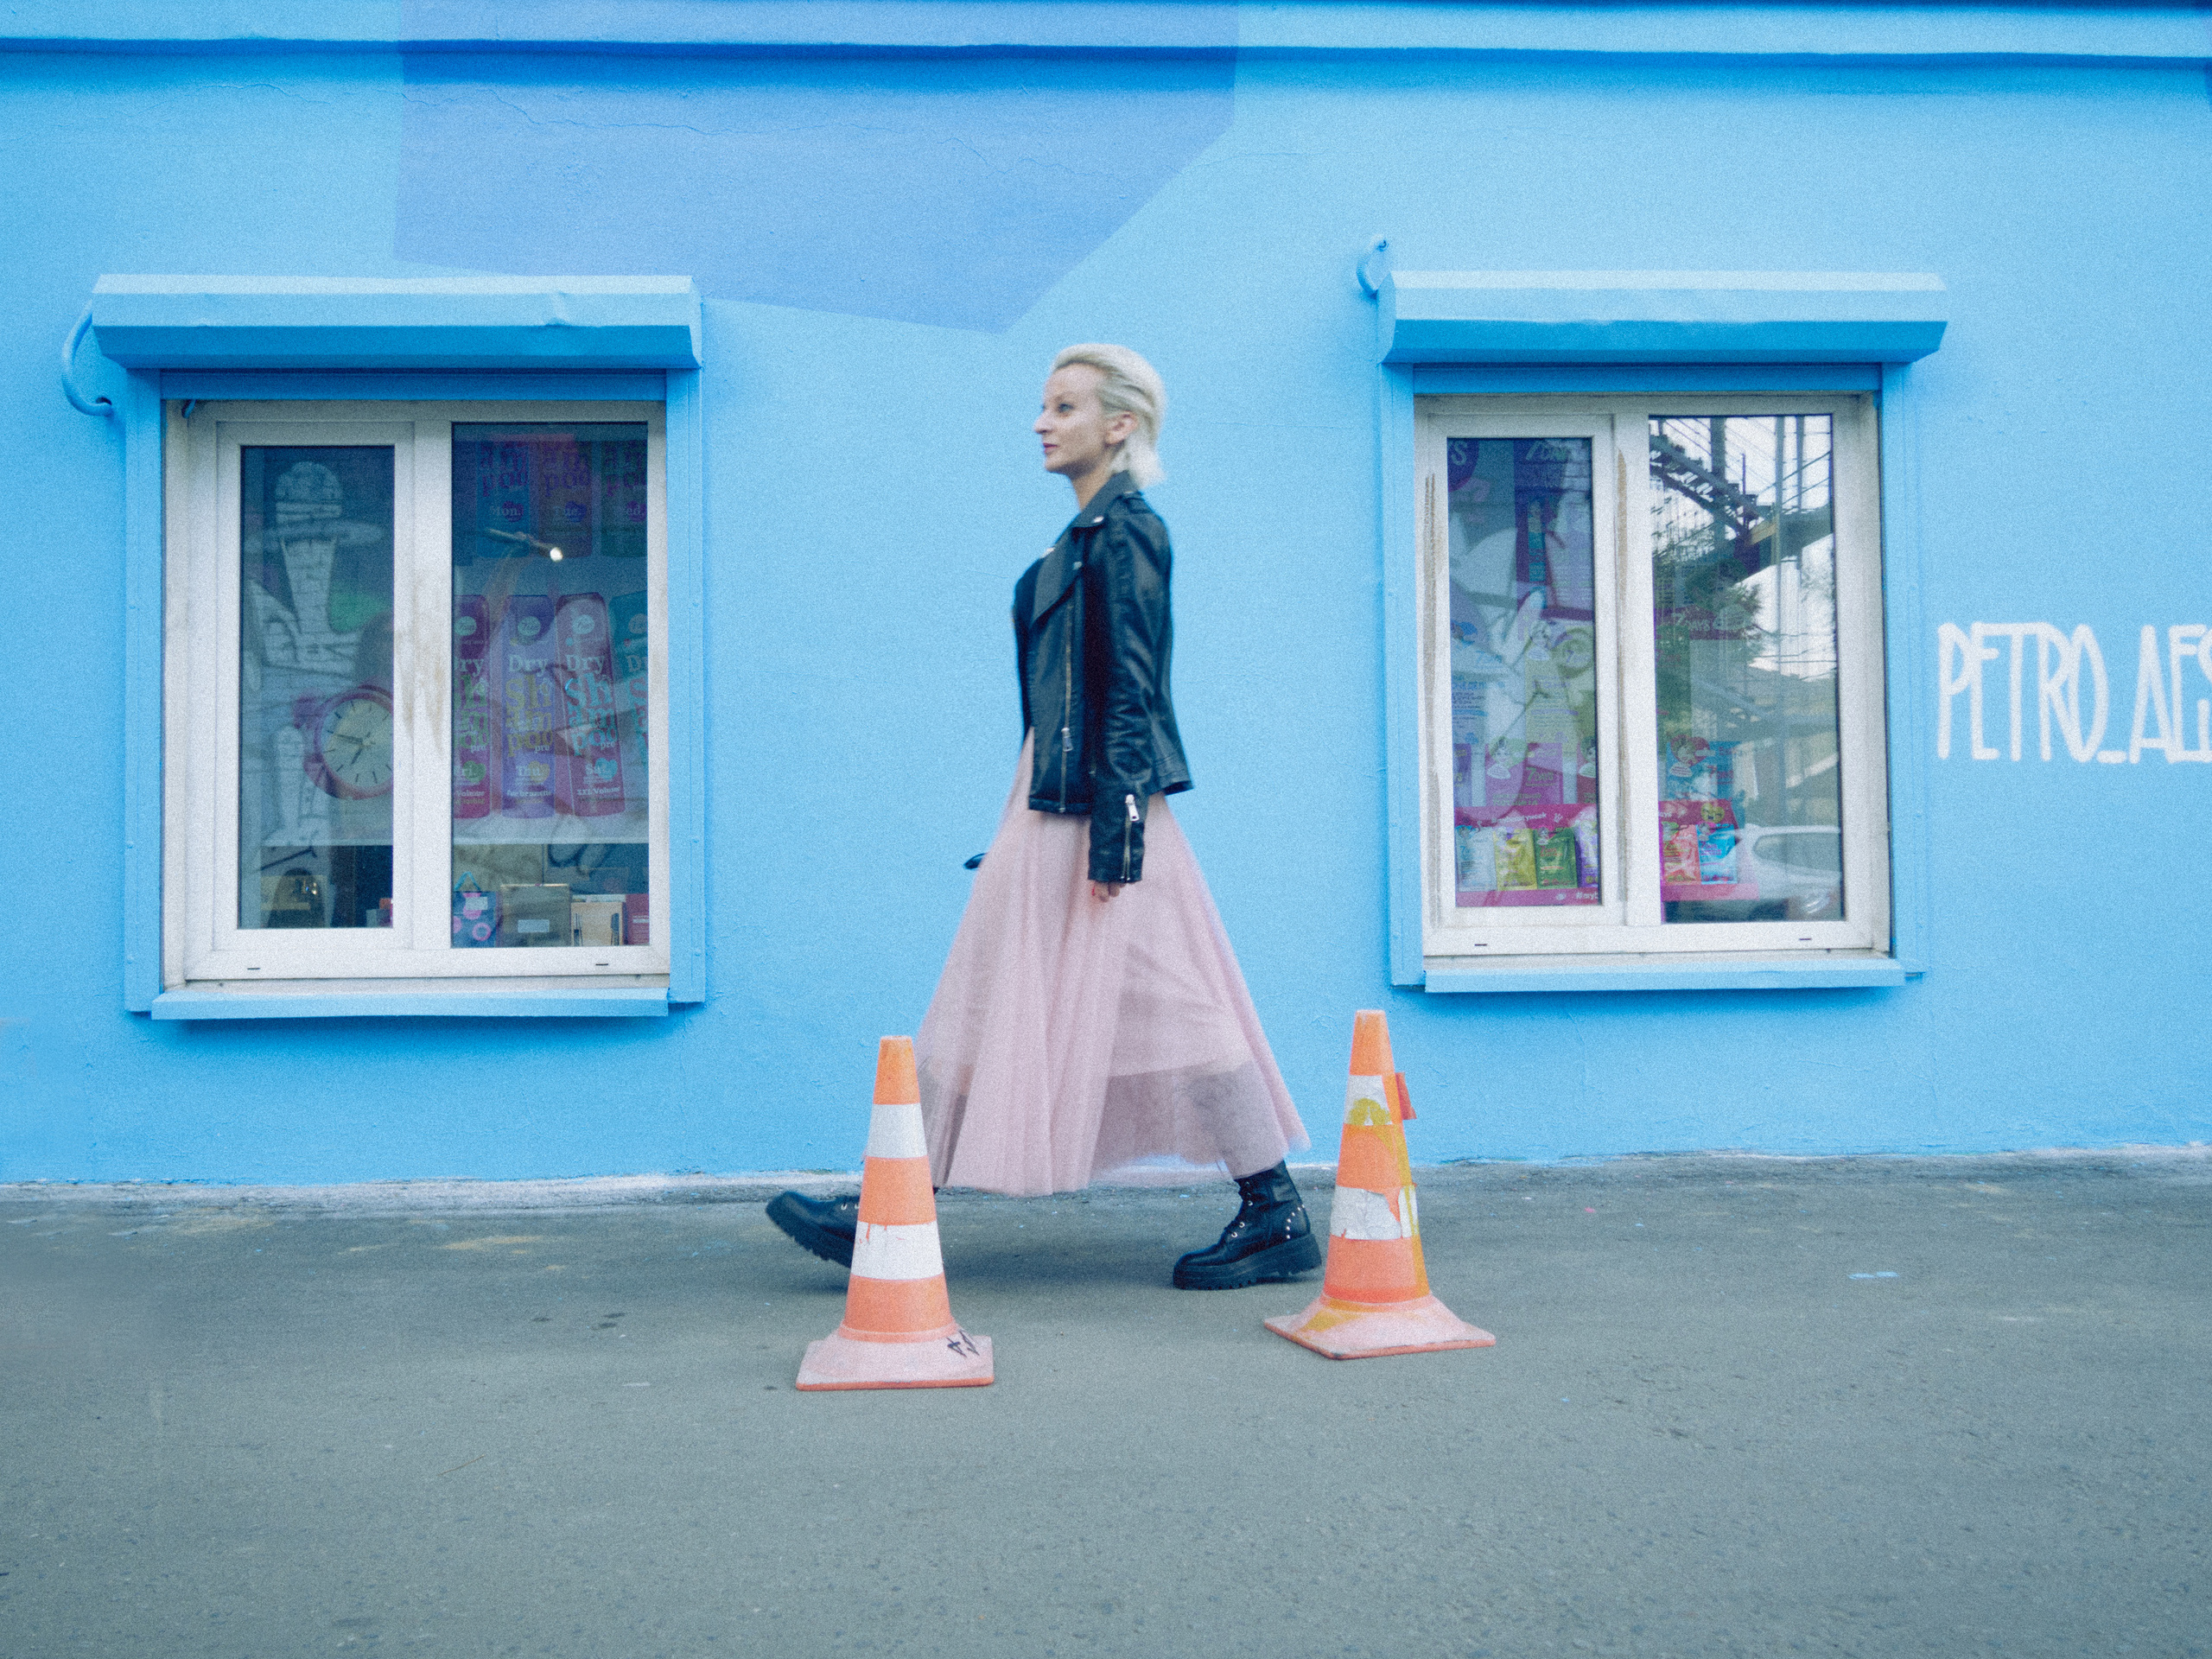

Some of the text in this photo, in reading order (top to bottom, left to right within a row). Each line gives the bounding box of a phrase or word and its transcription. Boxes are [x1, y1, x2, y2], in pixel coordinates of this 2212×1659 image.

[544, 470, 591, 498] poo
[508, 653, 550, 677] Dry
[565, 653, 605, 675] Dry
[507, 728, 553, 758] poo
[570, 725, 619, 758] poo
